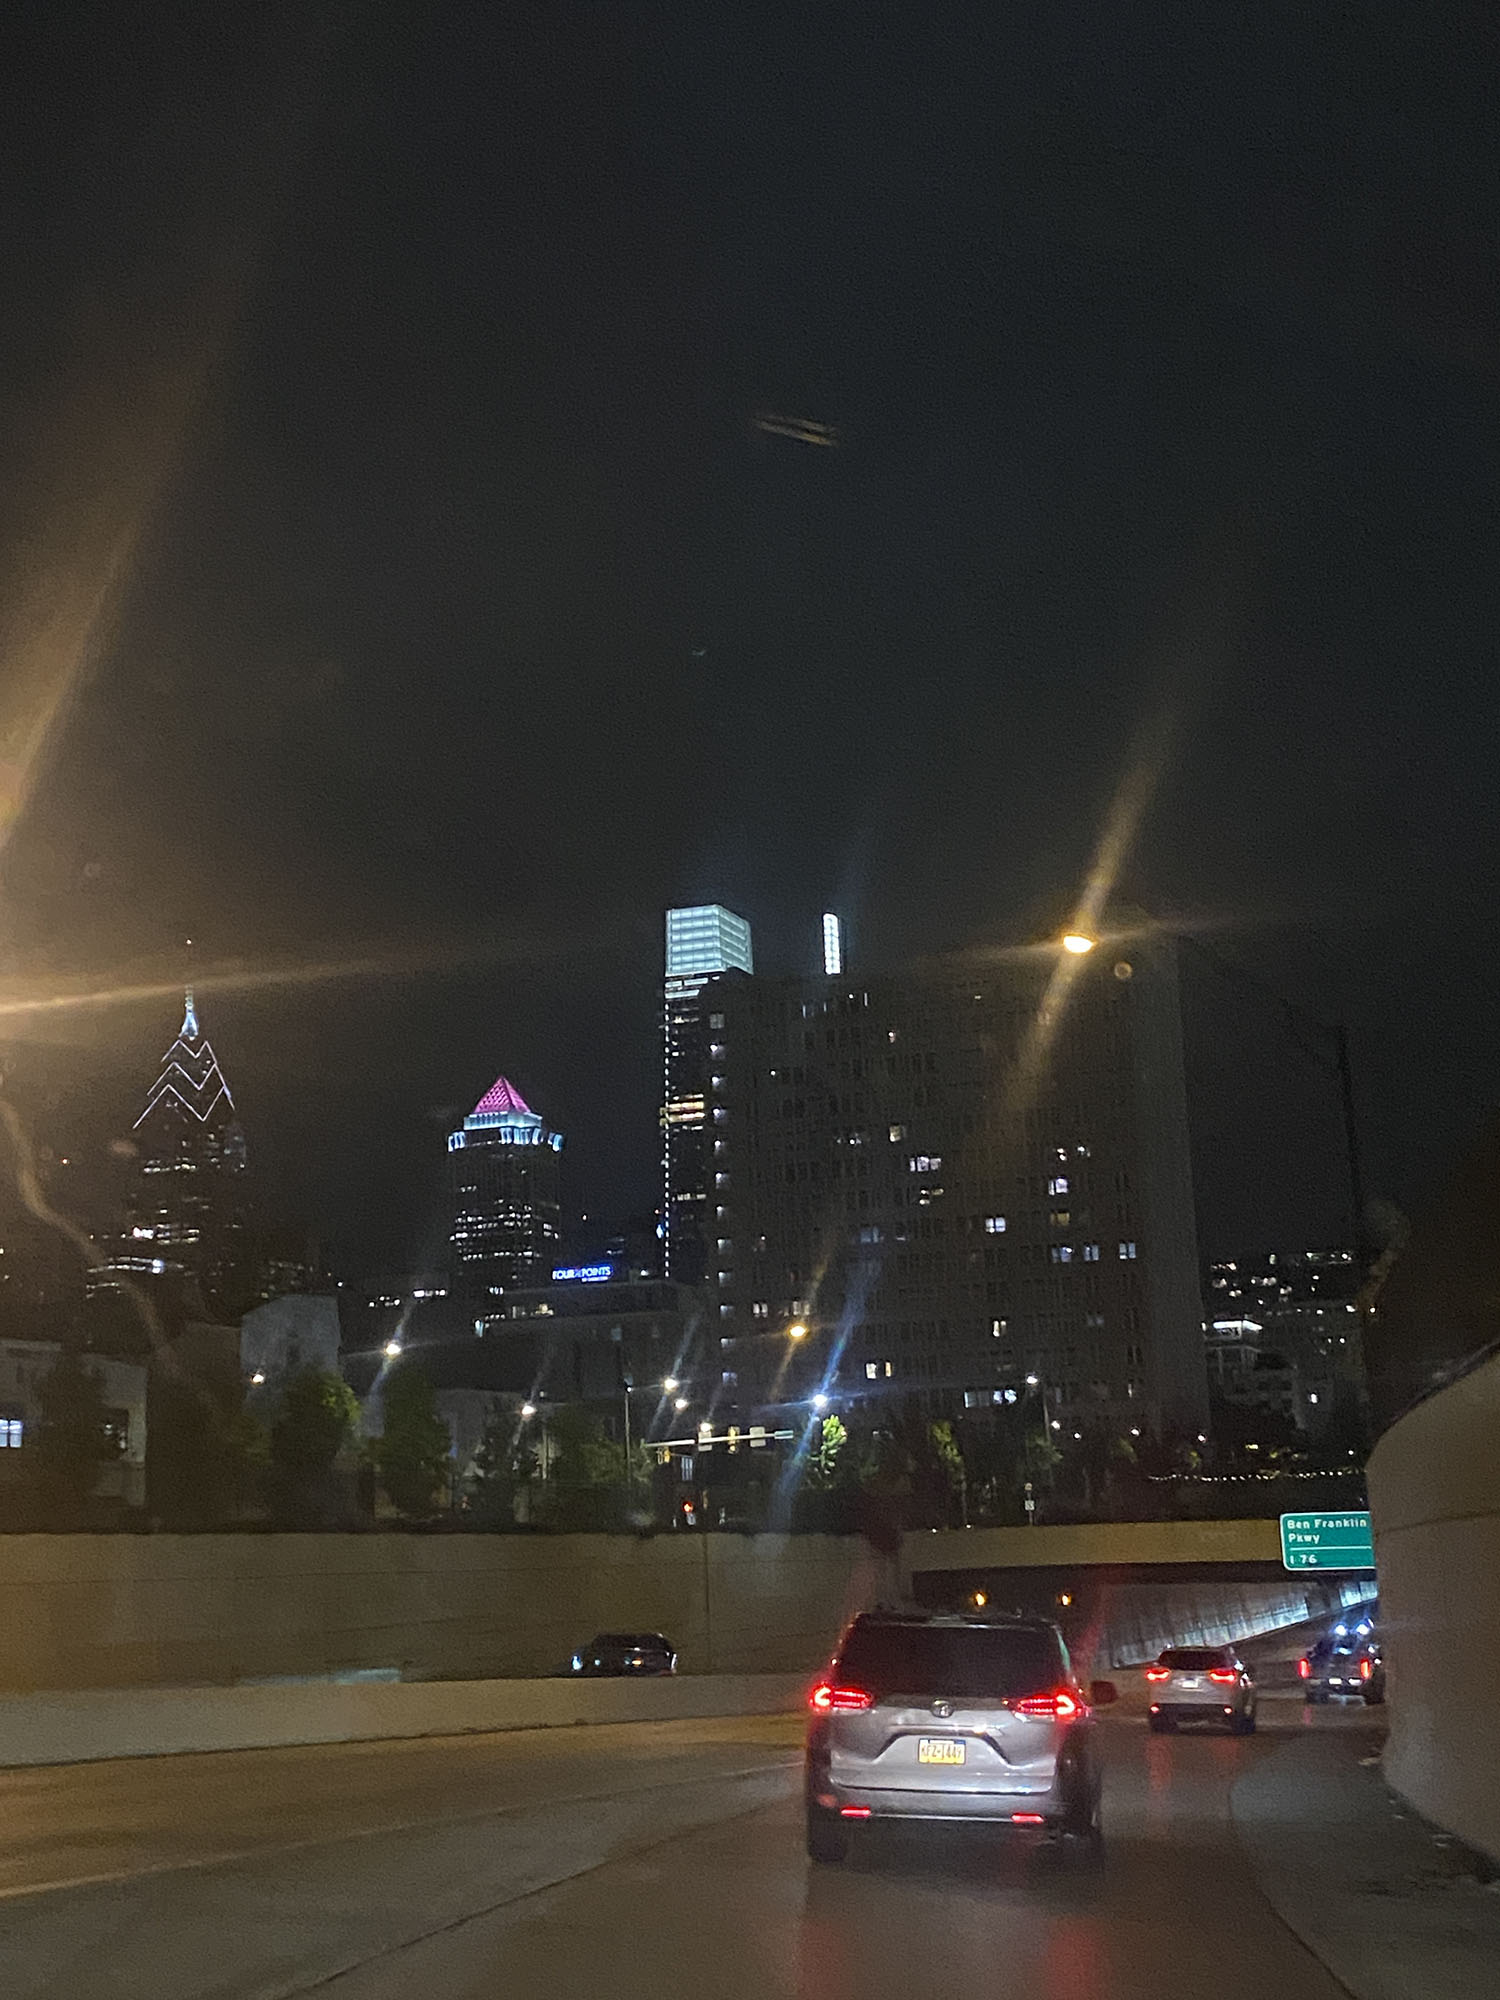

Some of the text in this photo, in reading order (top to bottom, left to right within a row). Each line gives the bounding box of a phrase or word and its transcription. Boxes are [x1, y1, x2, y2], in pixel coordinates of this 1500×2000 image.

[552, 1269, 575, 1280] FOUR
[581, 1266, 611, 1277] POINTS
[1287, 1518, 1367, 1529] Ben Franklin
[1288, 1533, 1320, 1544] Pkwy
[1300, 1554, 1318, 1564] 76
